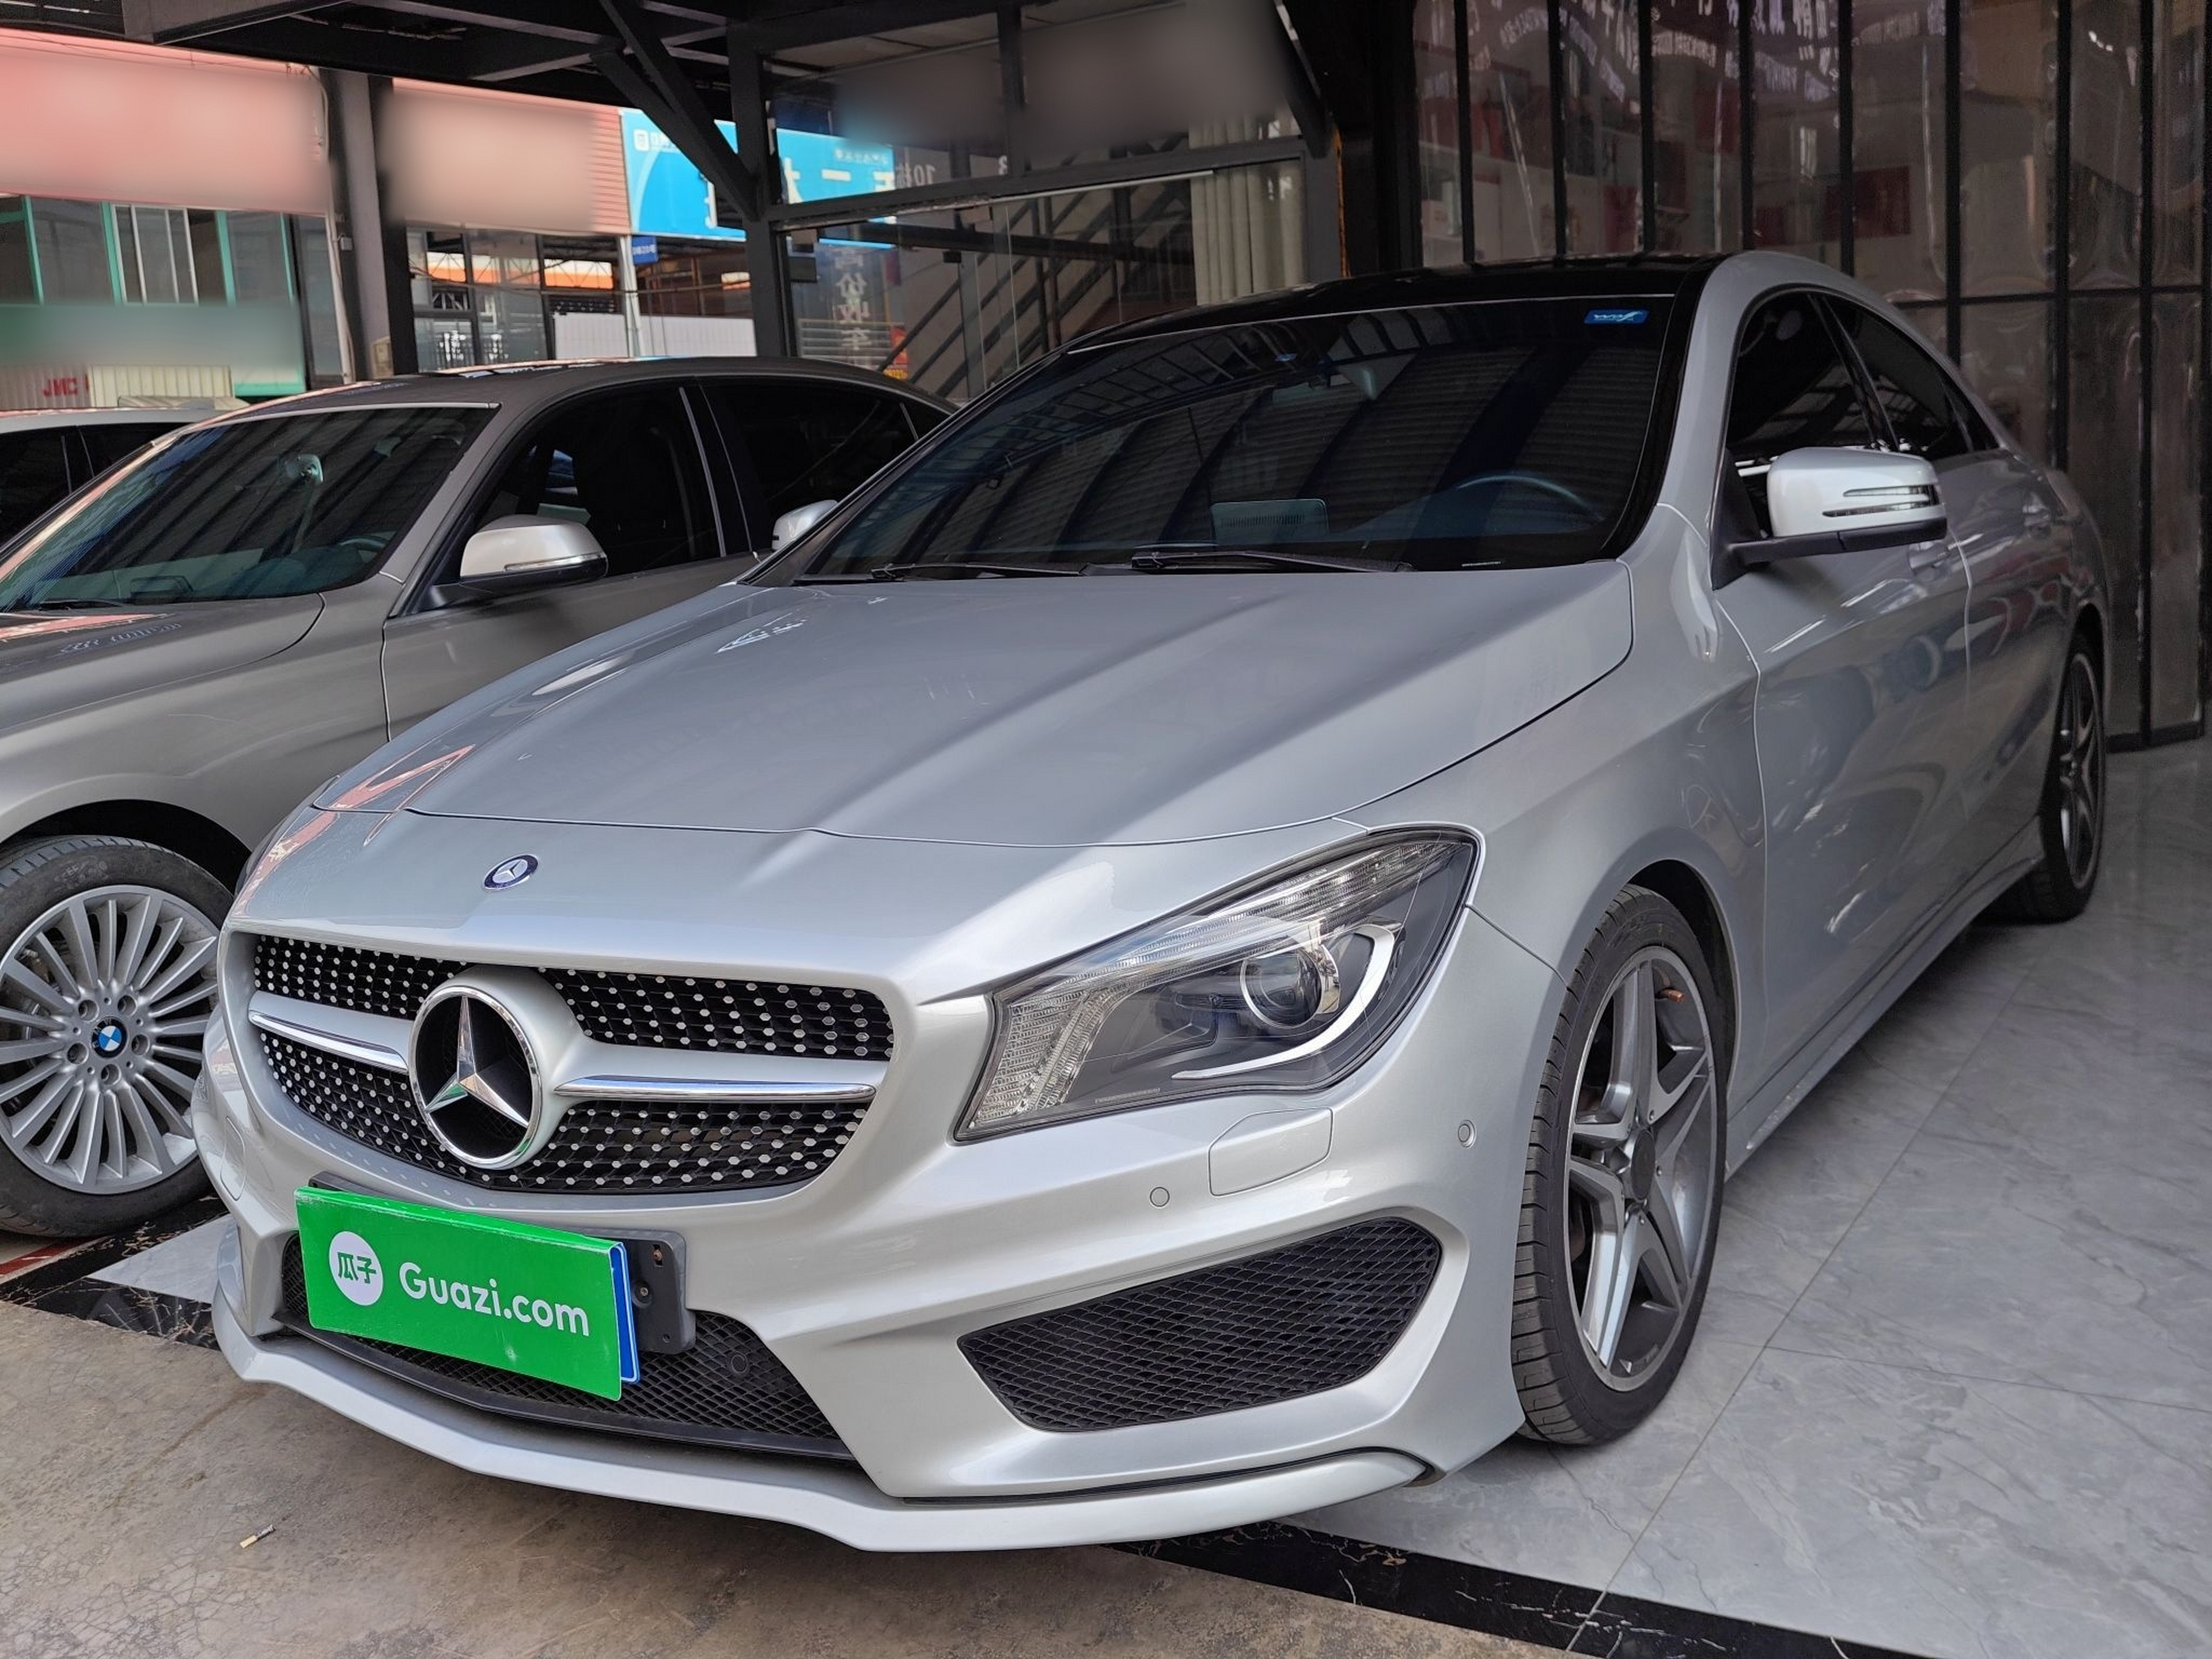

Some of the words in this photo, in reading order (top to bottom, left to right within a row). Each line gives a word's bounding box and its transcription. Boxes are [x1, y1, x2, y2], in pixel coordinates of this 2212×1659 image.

[43, 377, 77, 397] JMC
[337, 1252, 376, 1284] 瓜子
[399, 1262, 589, 1337] Guazi.com
